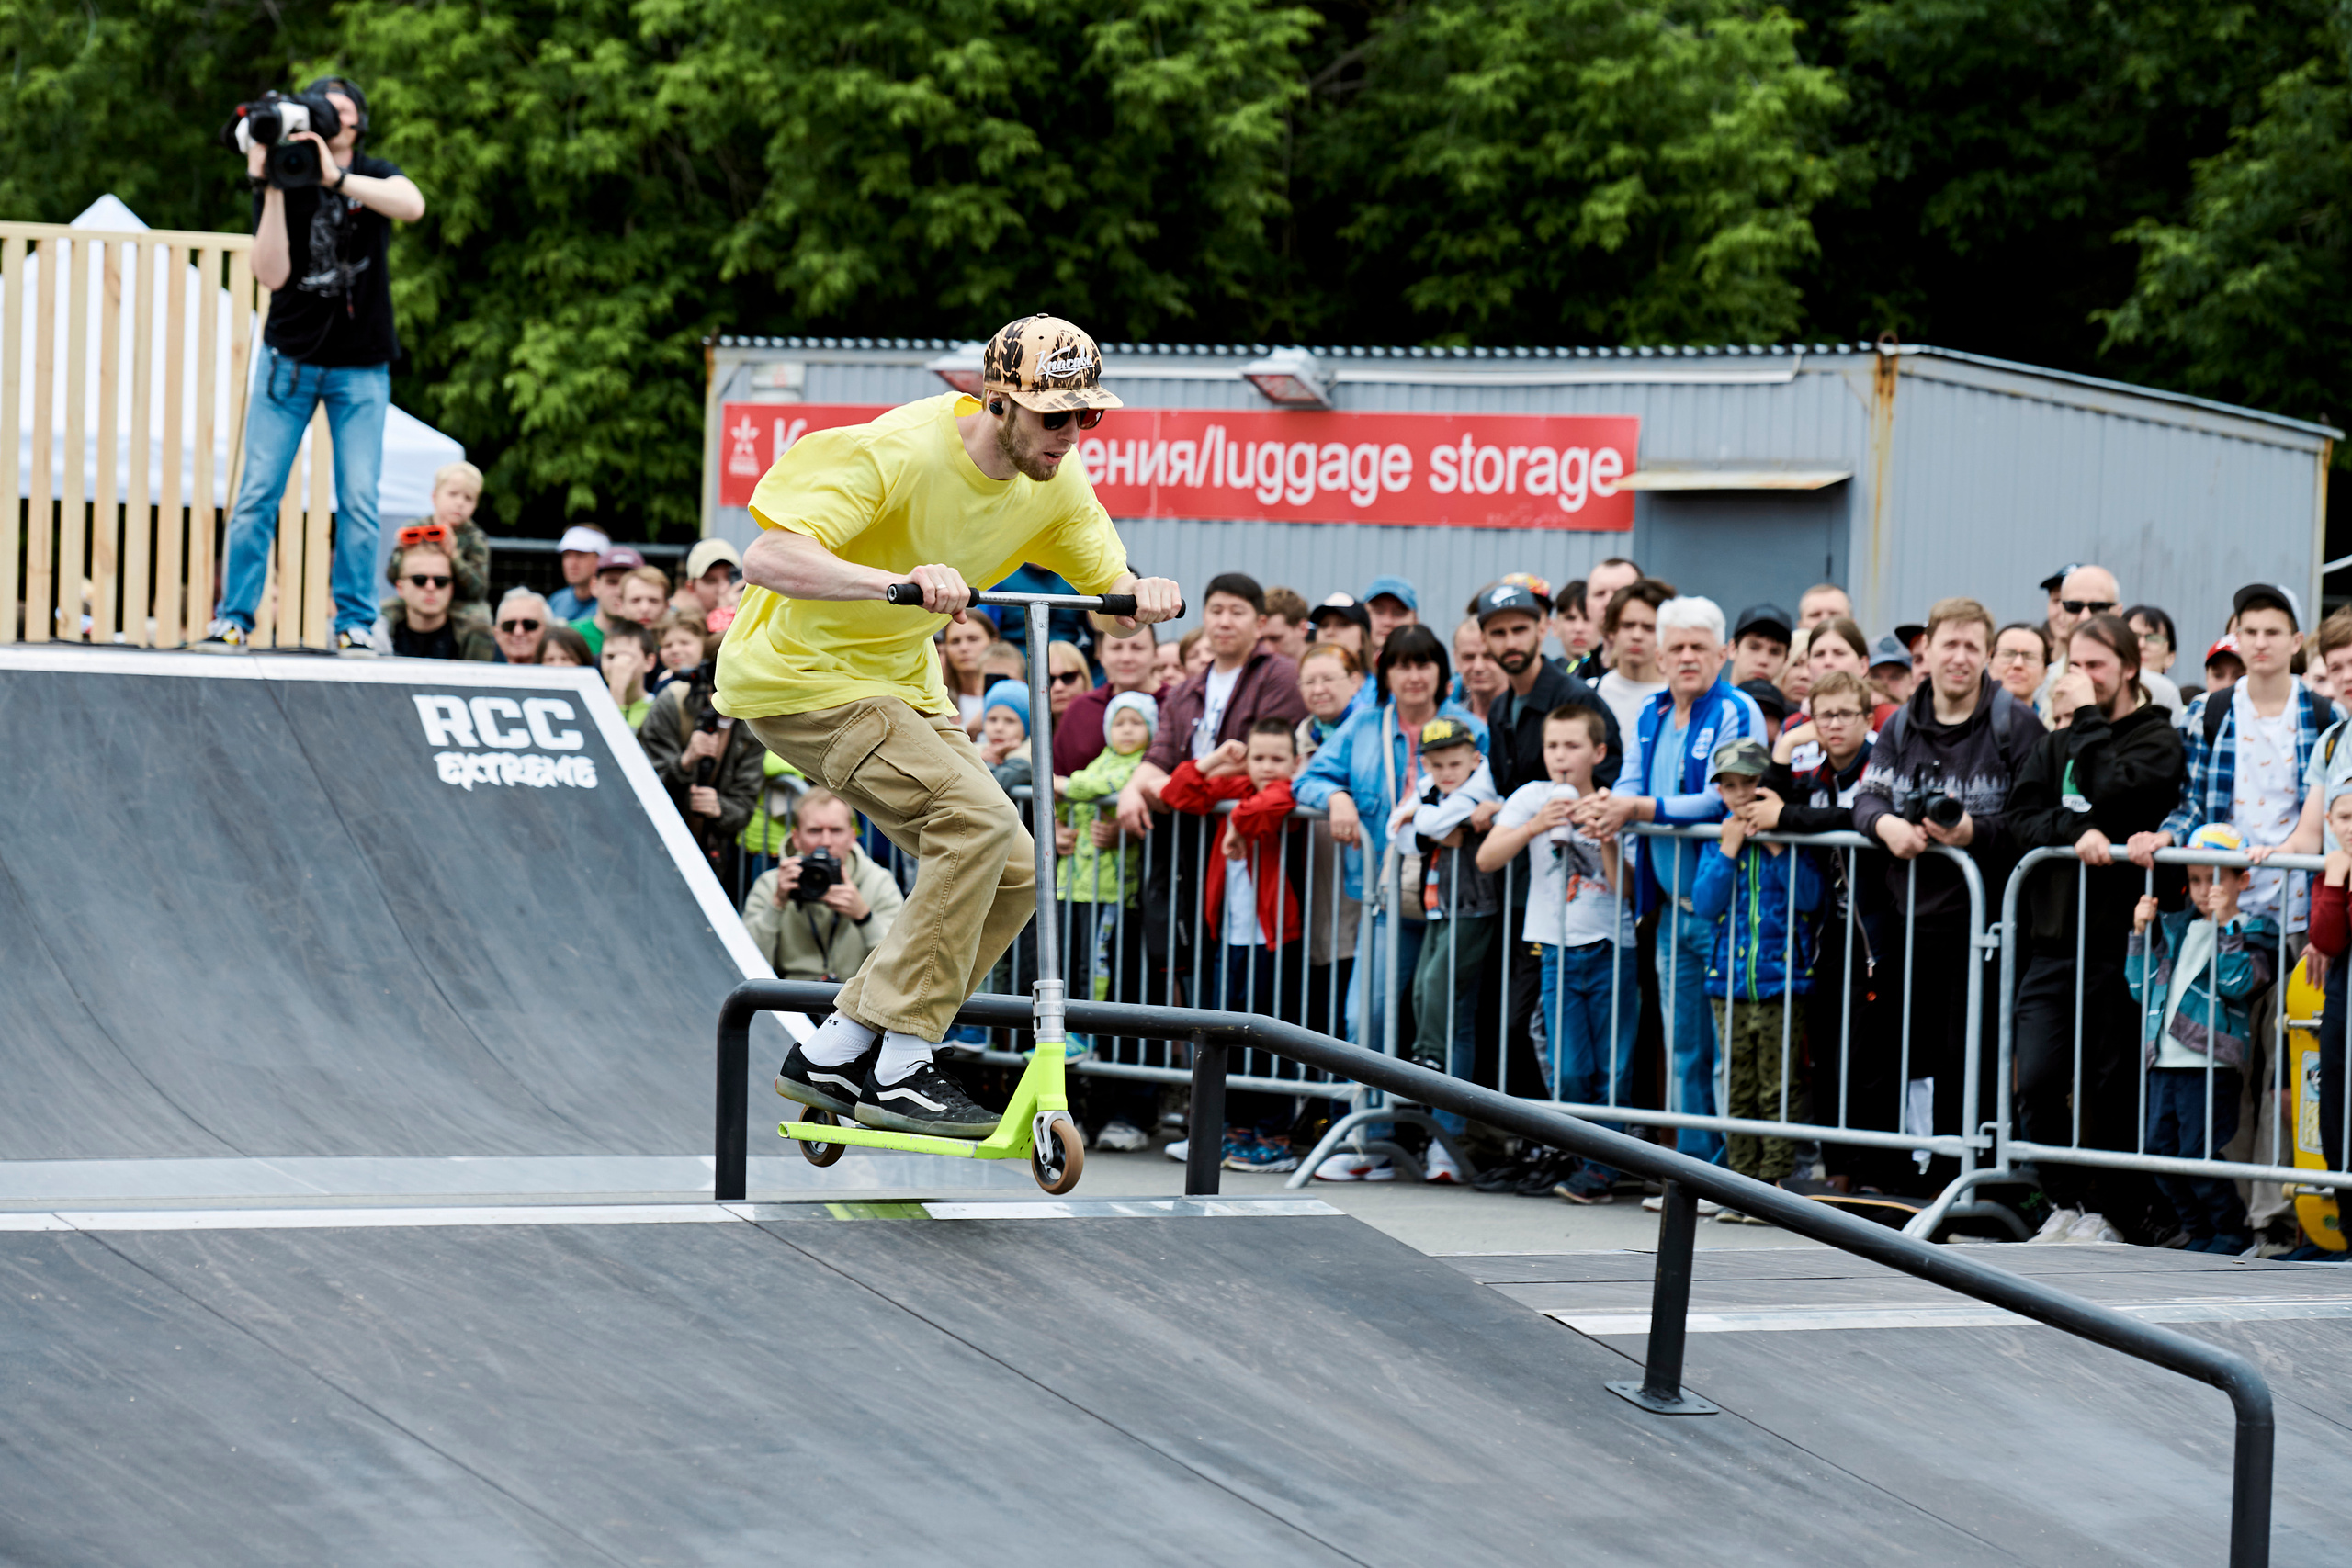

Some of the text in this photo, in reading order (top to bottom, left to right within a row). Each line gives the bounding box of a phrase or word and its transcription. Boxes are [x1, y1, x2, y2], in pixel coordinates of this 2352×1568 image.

[1079, 423, 1413, 508] ения/luggage
[1428, 432, 1623, 513] storage
[413, 694, 585, 751] RCC
